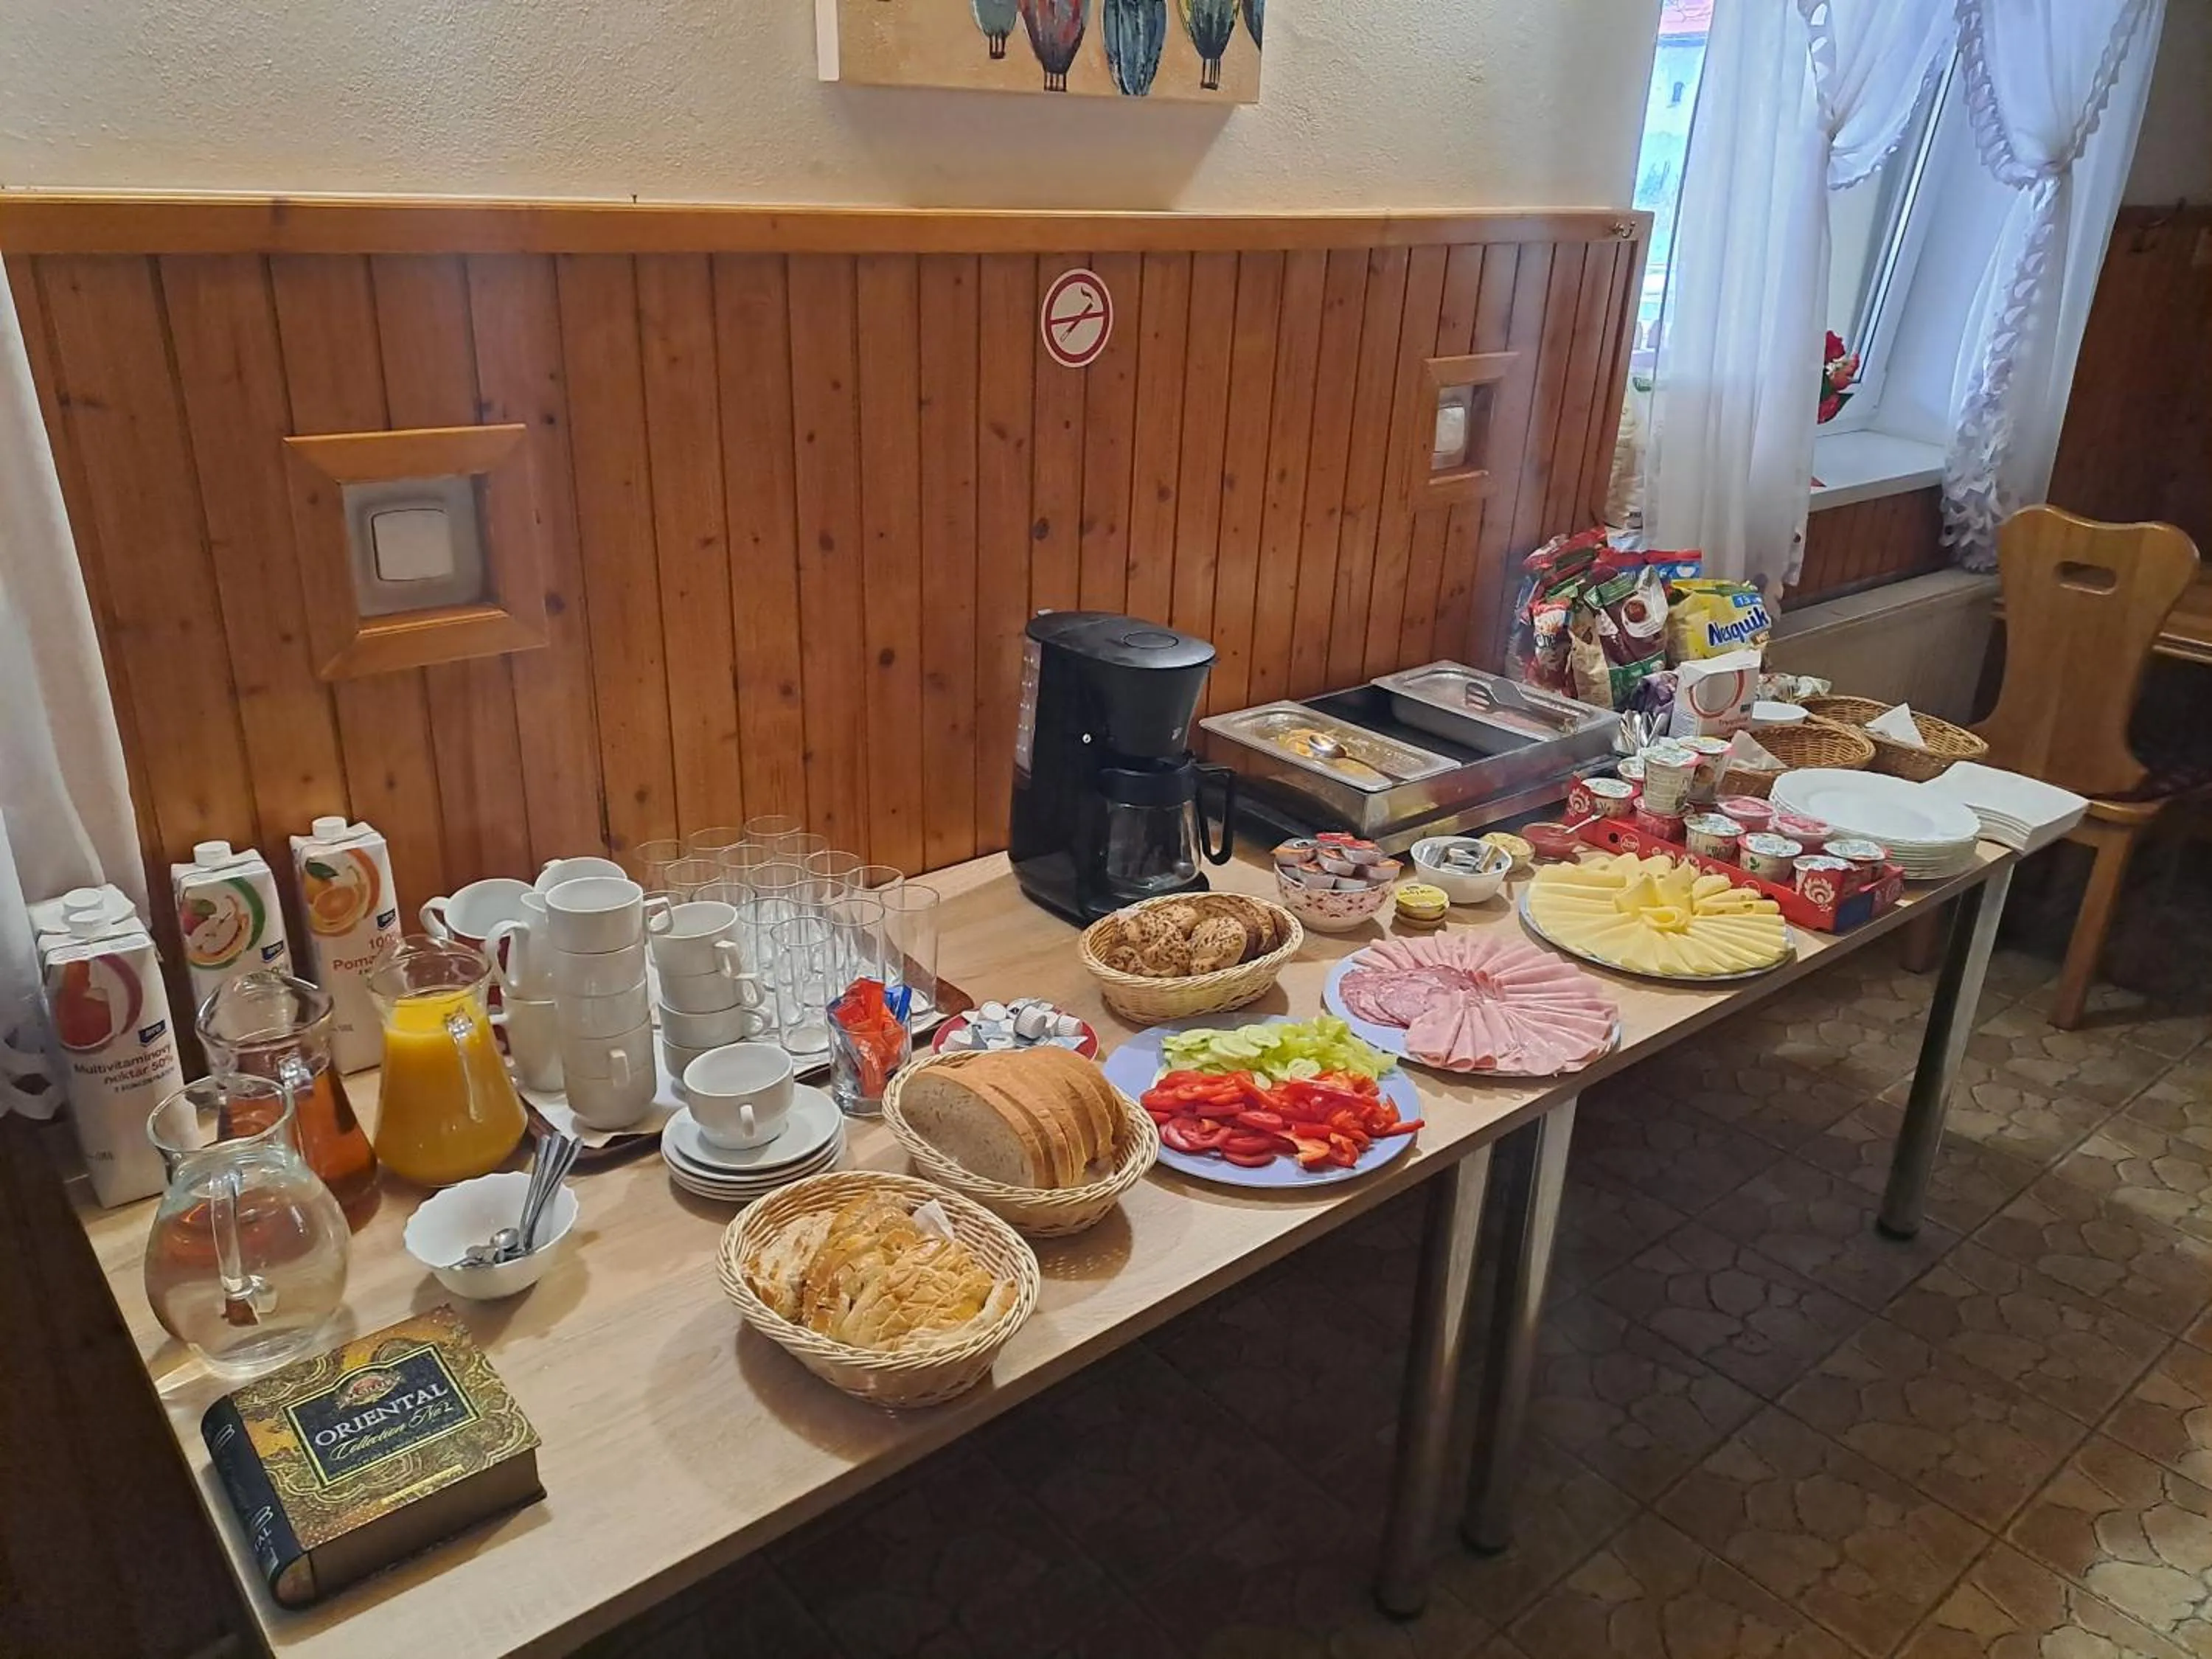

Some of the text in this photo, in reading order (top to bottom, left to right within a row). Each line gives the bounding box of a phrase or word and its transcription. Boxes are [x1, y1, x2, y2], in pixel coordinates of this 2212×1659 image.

[1708, 606, 1769, 646] Nesquik
[314, 1382, 449, 1446] ORIENTAL
[330, 1423, 405, 1461] Collection
